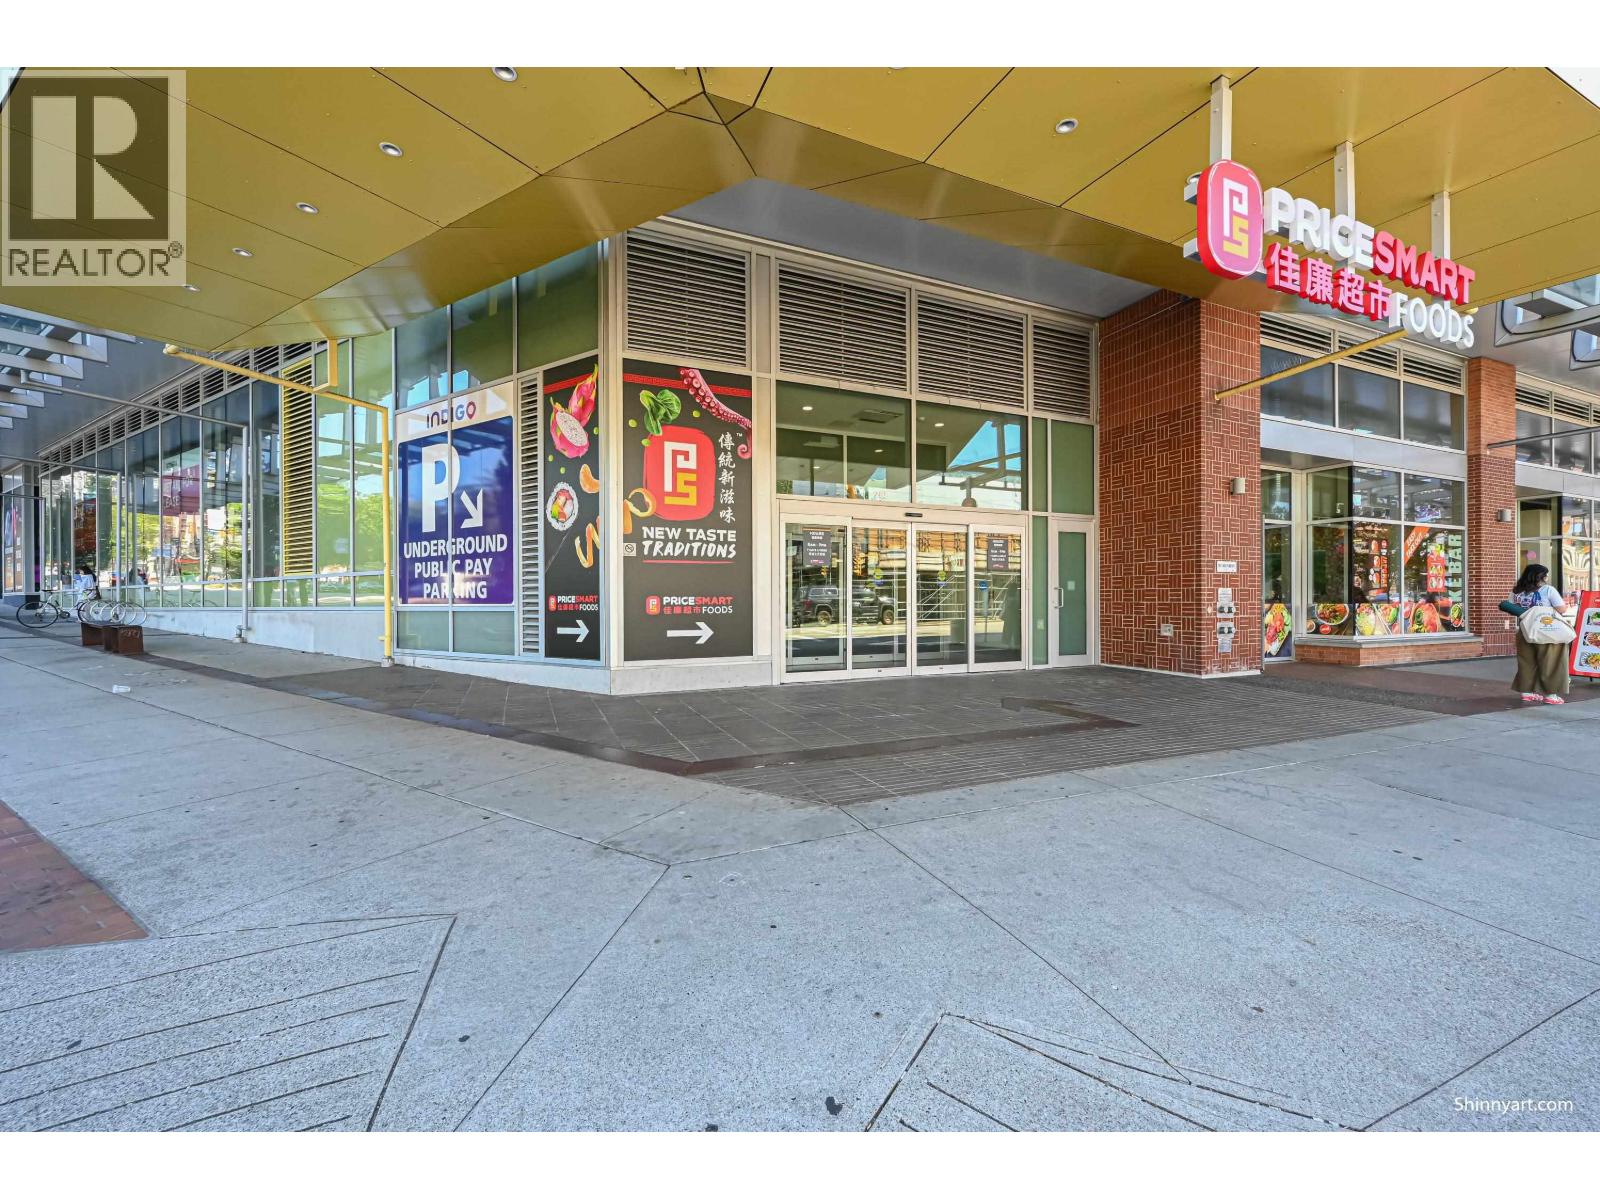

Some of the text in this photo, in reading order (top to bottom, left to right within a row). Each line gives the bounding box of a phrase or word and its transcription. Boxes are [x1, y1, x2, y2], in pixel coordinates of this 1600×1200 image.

[1263, 187, 1476, 304] PRICESMART
[1266, 242, 1392, 321] 佳廉超市
[1388, 292, 1475, 349] FOODS
[427, 401, 477, 428] INDIGO
[421, 443, 461, 533] P
[718, 431, 736, 524] 傳統新滋味
[403, 533, 508, 559] UNDERGROUND
[642, 526, 736, 542] NEW TASTE
[642, 540, 737, 559] TRADITIONS
[414, 557, 493, 579] PUBLC PAY
[557, 595, 598, 604] PRICESMART
[579, 603, 599, 611] FOODS
[663, 596, 734, 606] PRICESMART
[702, 605, 733, 614] FOODS
